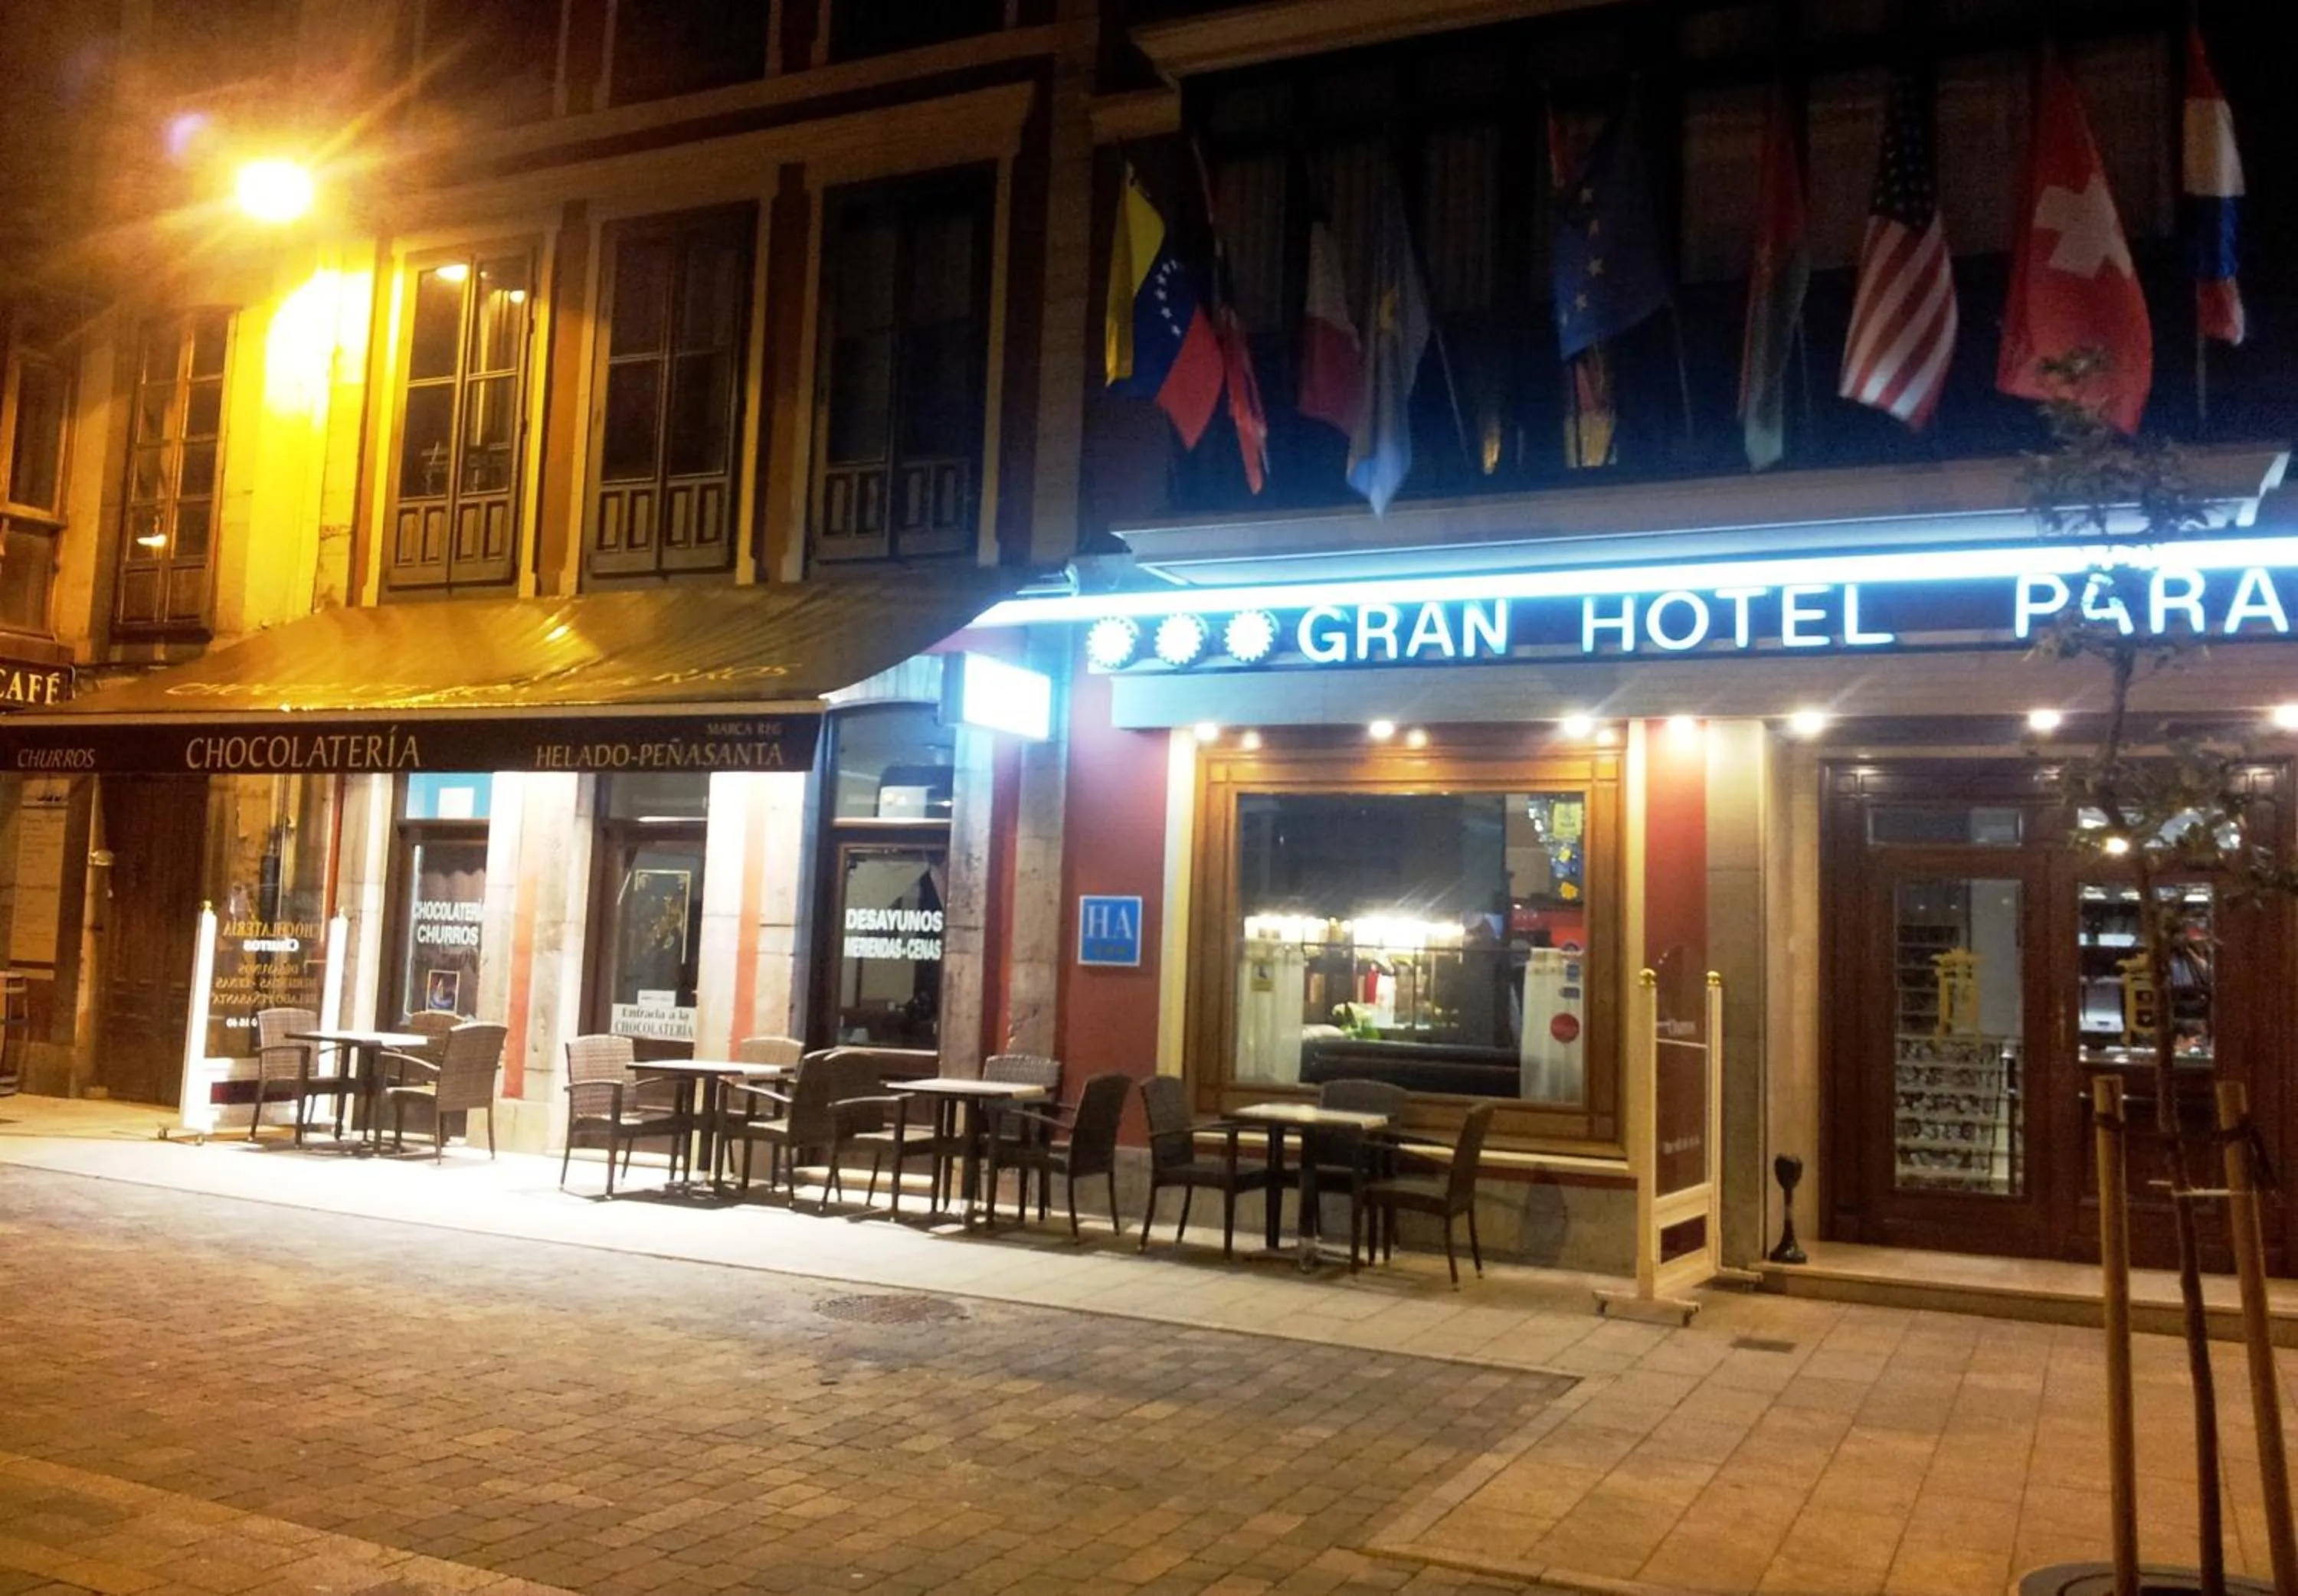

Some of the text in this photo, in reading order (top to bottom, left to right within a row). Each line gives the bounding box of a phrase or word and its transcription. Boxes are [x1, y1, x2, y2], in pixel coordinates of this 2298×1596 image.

[1297, 597, 1510, 663] GRAN
[1582, 583, 1894, 652] HOTEL
[708, 722, 751, 734] MARCA
[186, 724, 421, 768] CHOCOLATERÍA
[537, 737, 784, 767] HELADO-PEÑASANTA
[18, 748, 95, 768] CHURROS
[845, 908, 944, 932] DESAYUNOS
[417, 924, 479, 946] CHURROS
[622, 1008, 665, 1019] Entrada
[679, 1009, 689, 1020] la
